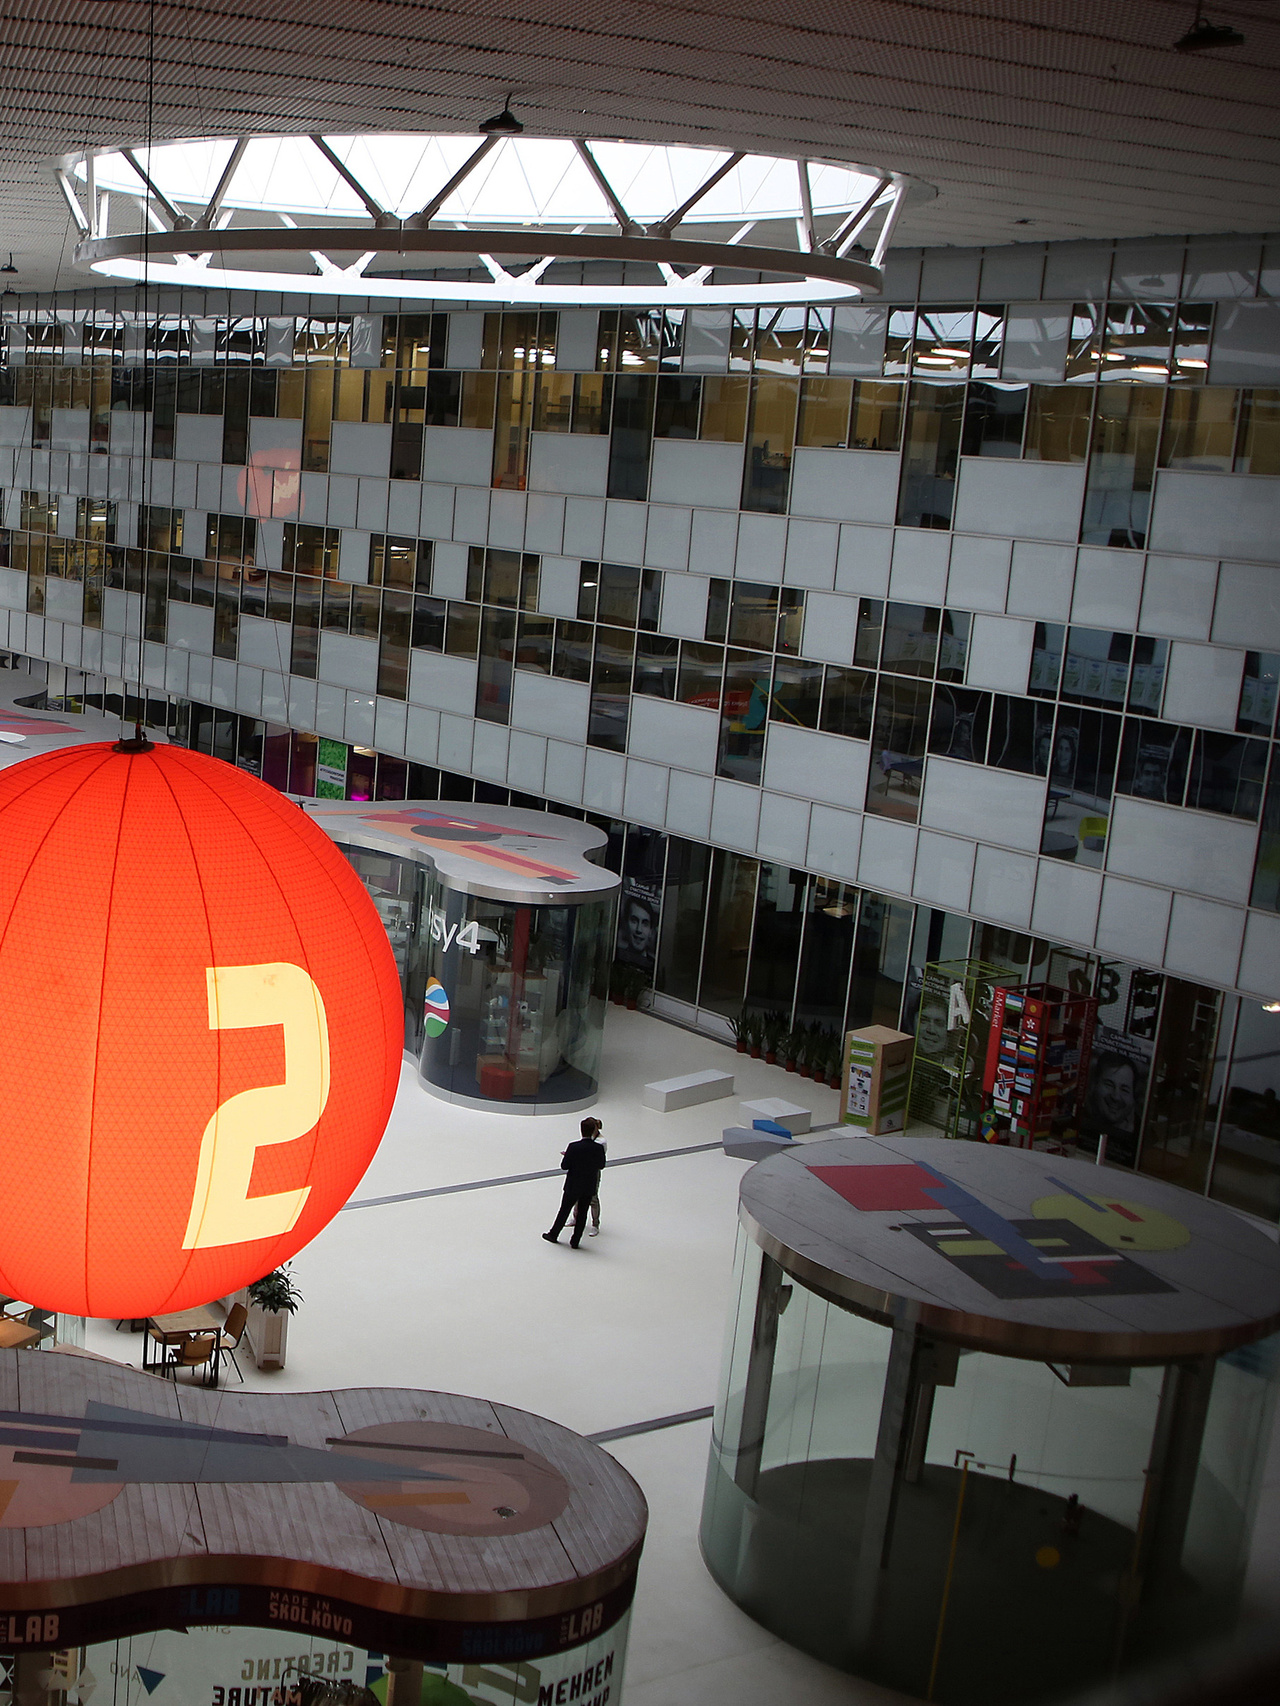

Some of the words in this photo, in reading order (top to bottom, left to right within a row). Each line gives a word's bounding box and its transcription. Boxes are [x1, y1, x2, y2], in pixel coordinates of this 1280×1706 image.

[991, 991, 1004, 1028] I-Market
[181, 962, 331, 1250] 2
[189, 1588, 241, 1616] LAB
[270, 1591, 309, 1607] MADE
[316, 1600, 330, 1612] IN
[8, 1614, 60, 1643] LAB
[269, 1602, 353, 1636] SKOLKOVO
[568, 1602, 604, 1642] LAB
